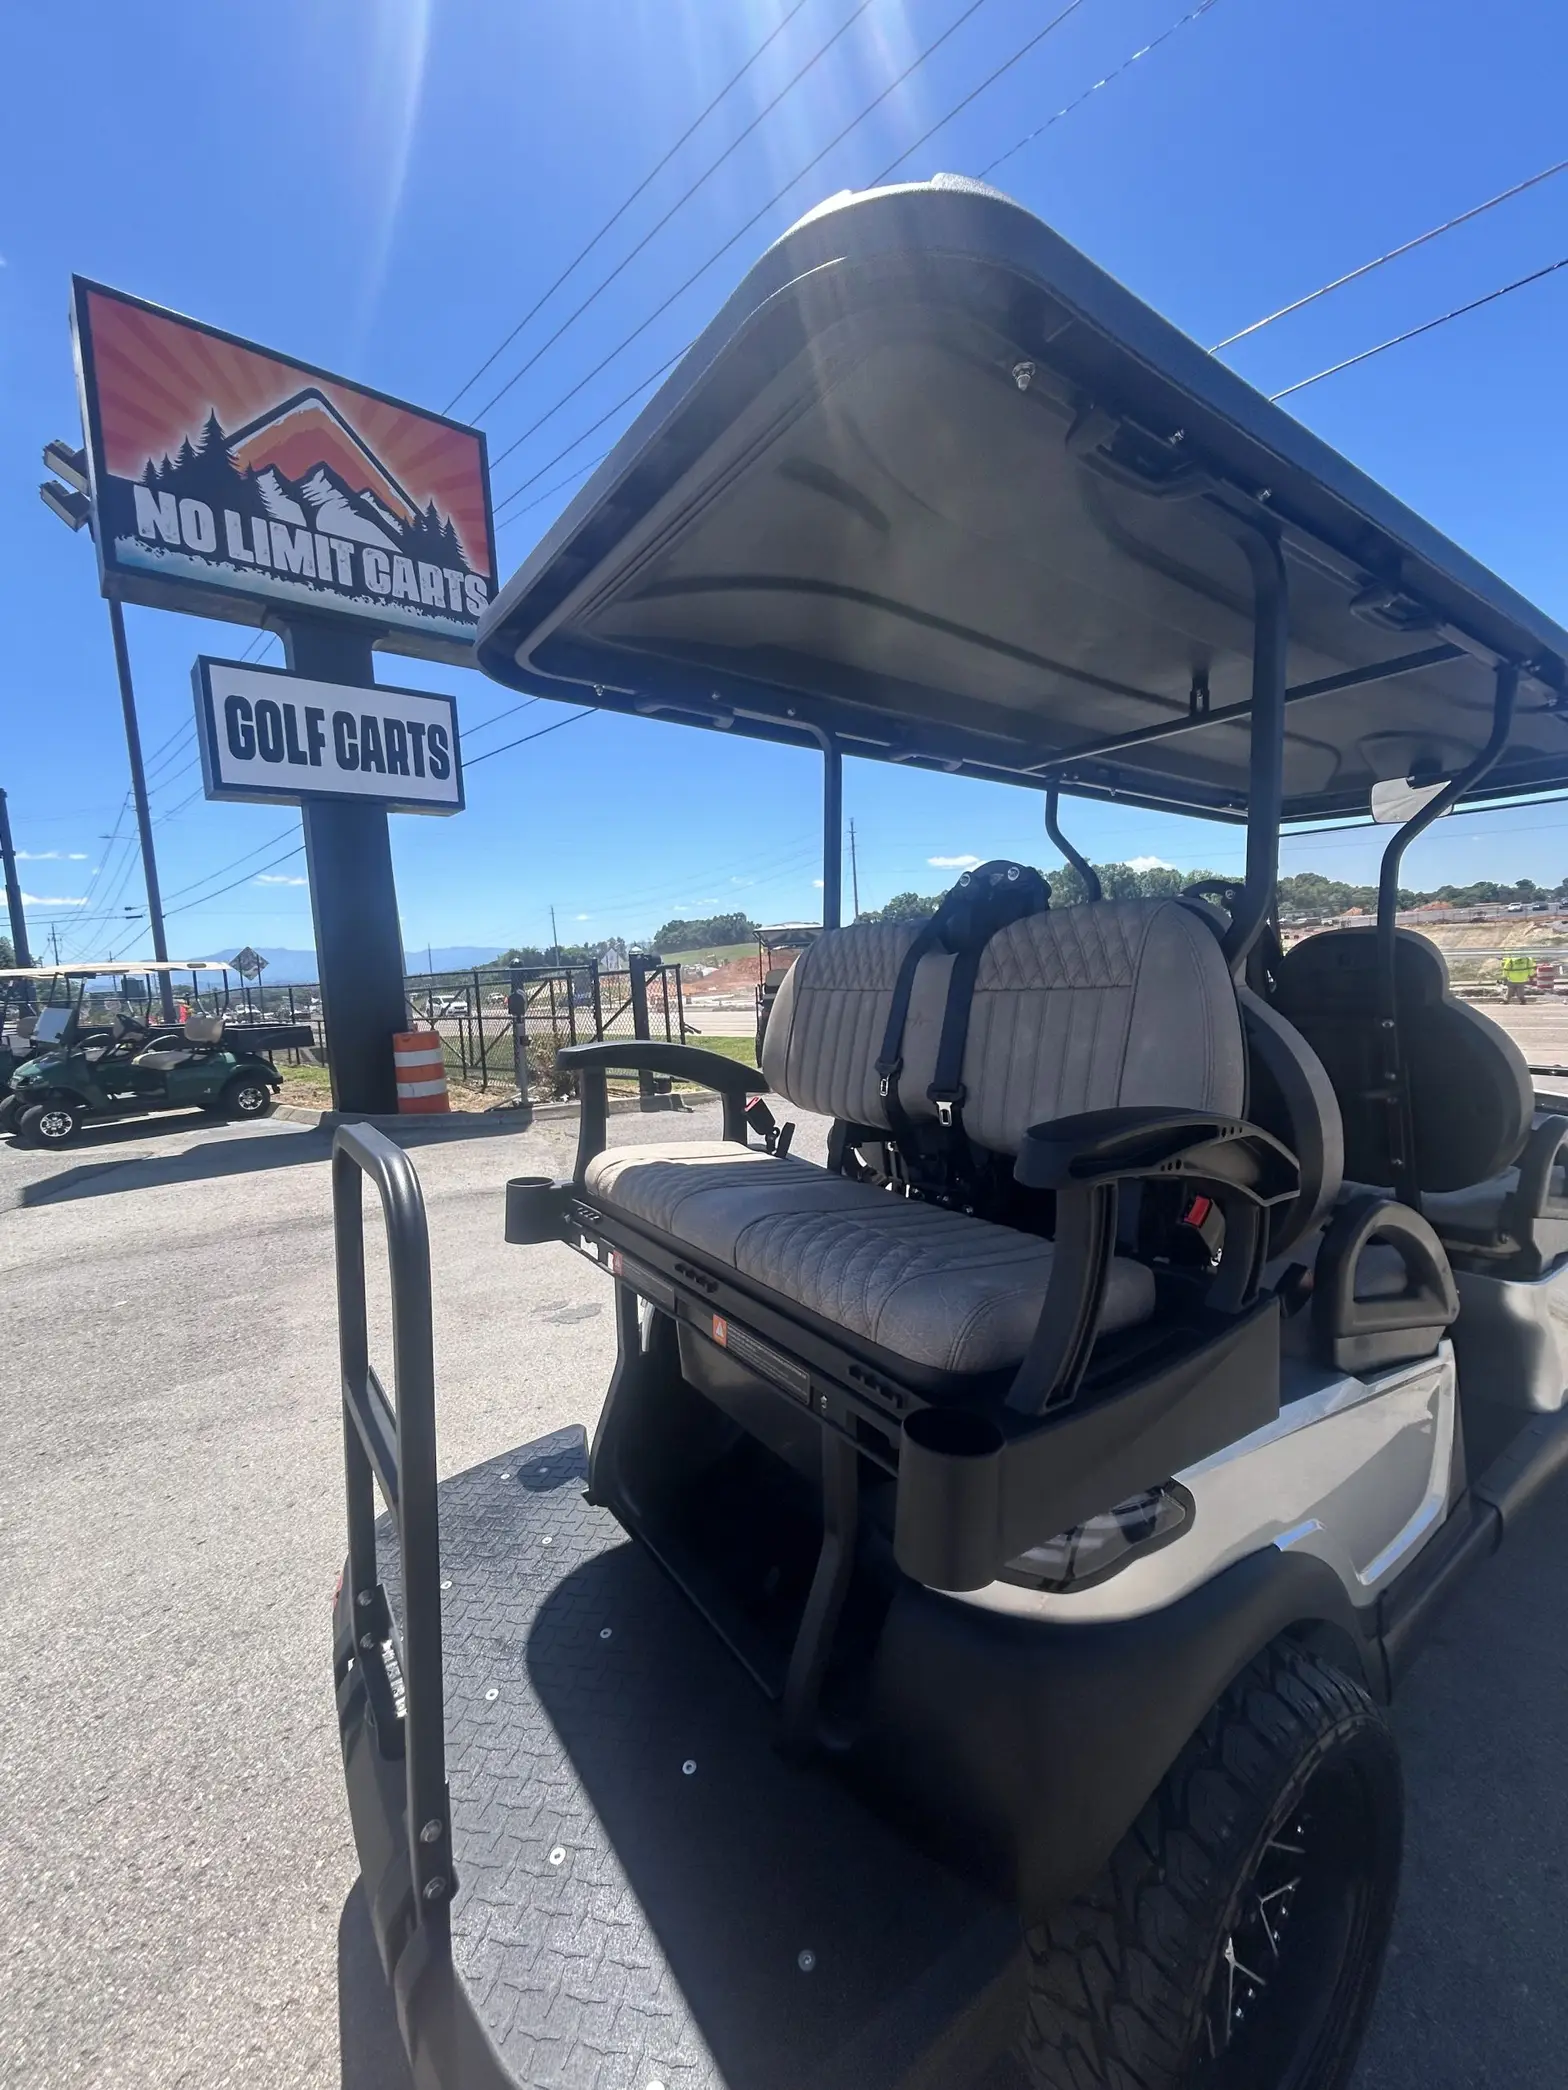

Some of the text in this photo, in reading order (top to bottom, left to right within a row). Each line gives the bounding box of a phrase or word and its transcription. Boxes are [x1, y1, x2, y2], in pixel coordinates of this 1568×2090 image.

[133, 484, 489, 617] NO LIMIT CARTS
[224, 695, 450, 780] GOLF CARTS
